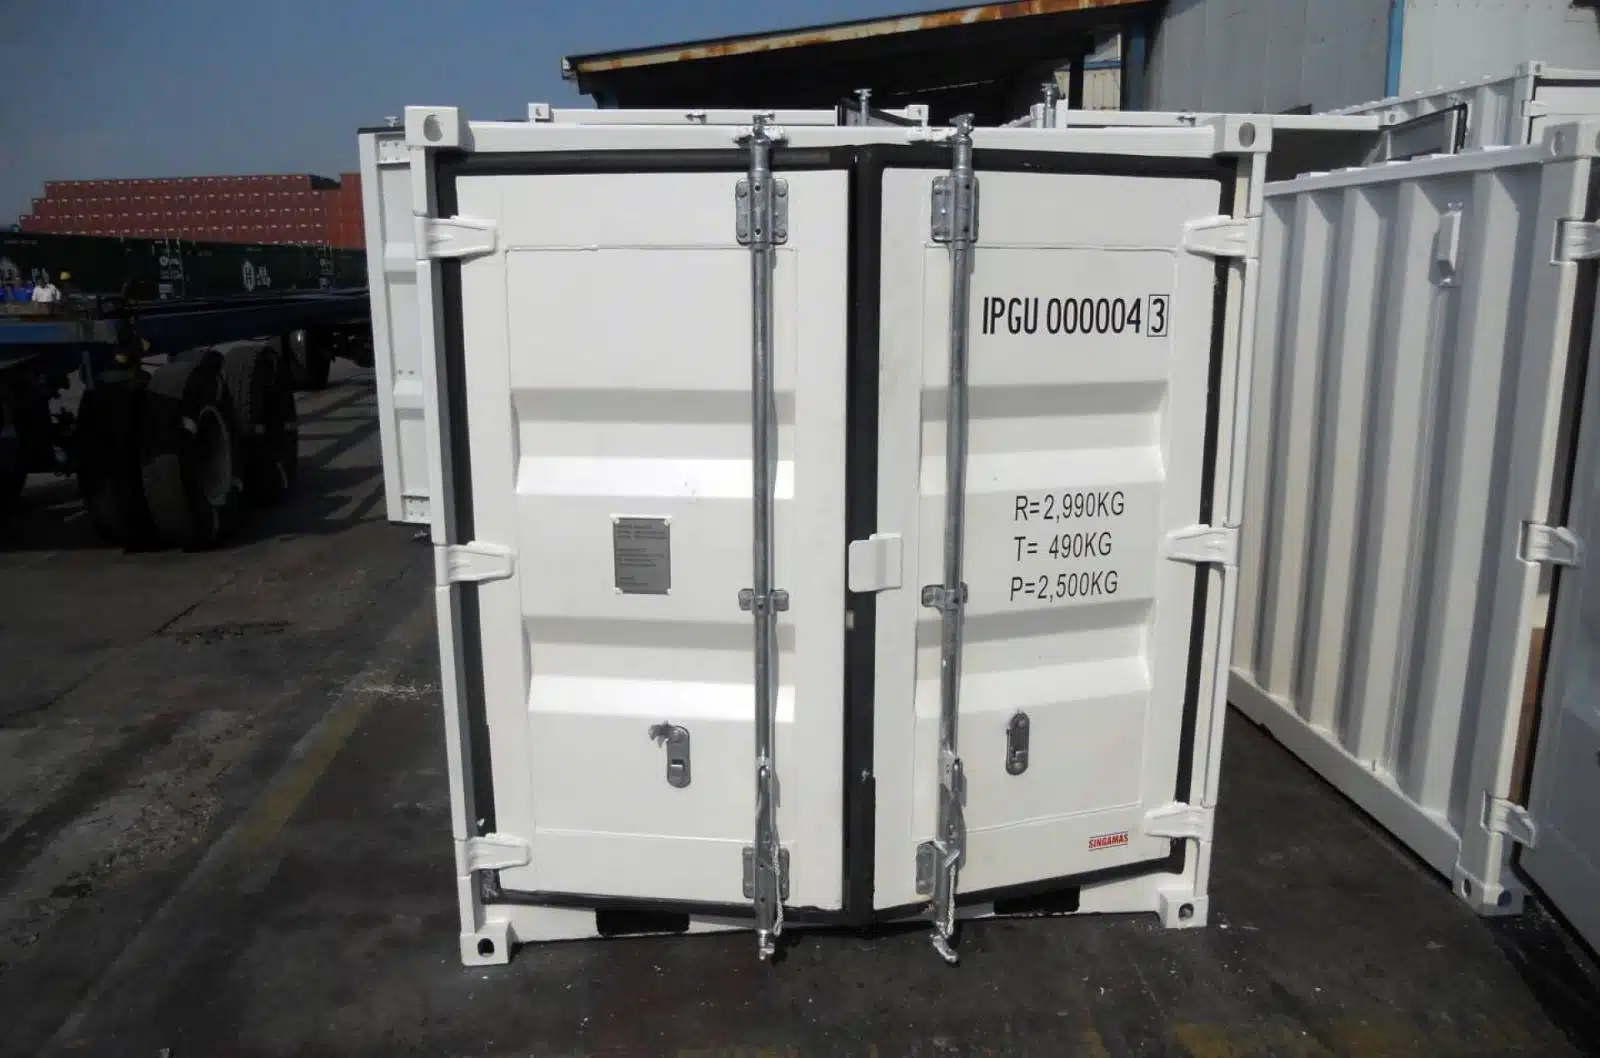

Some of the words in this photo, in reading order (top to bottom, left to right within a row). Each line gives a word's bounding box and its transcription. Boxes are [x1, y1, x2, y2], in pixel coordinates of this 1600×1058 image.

[982, 296, 1039, 335] IPGU
[1046, 297, 1142, 335] 000004
[1151, 297, 1166, 334] 3
[1048, 531, 1113, 561] 490KG
[1009, 570, 1119, 603] P=2,500KG
[1088, 832, 1129, 849] SINGAMAS
